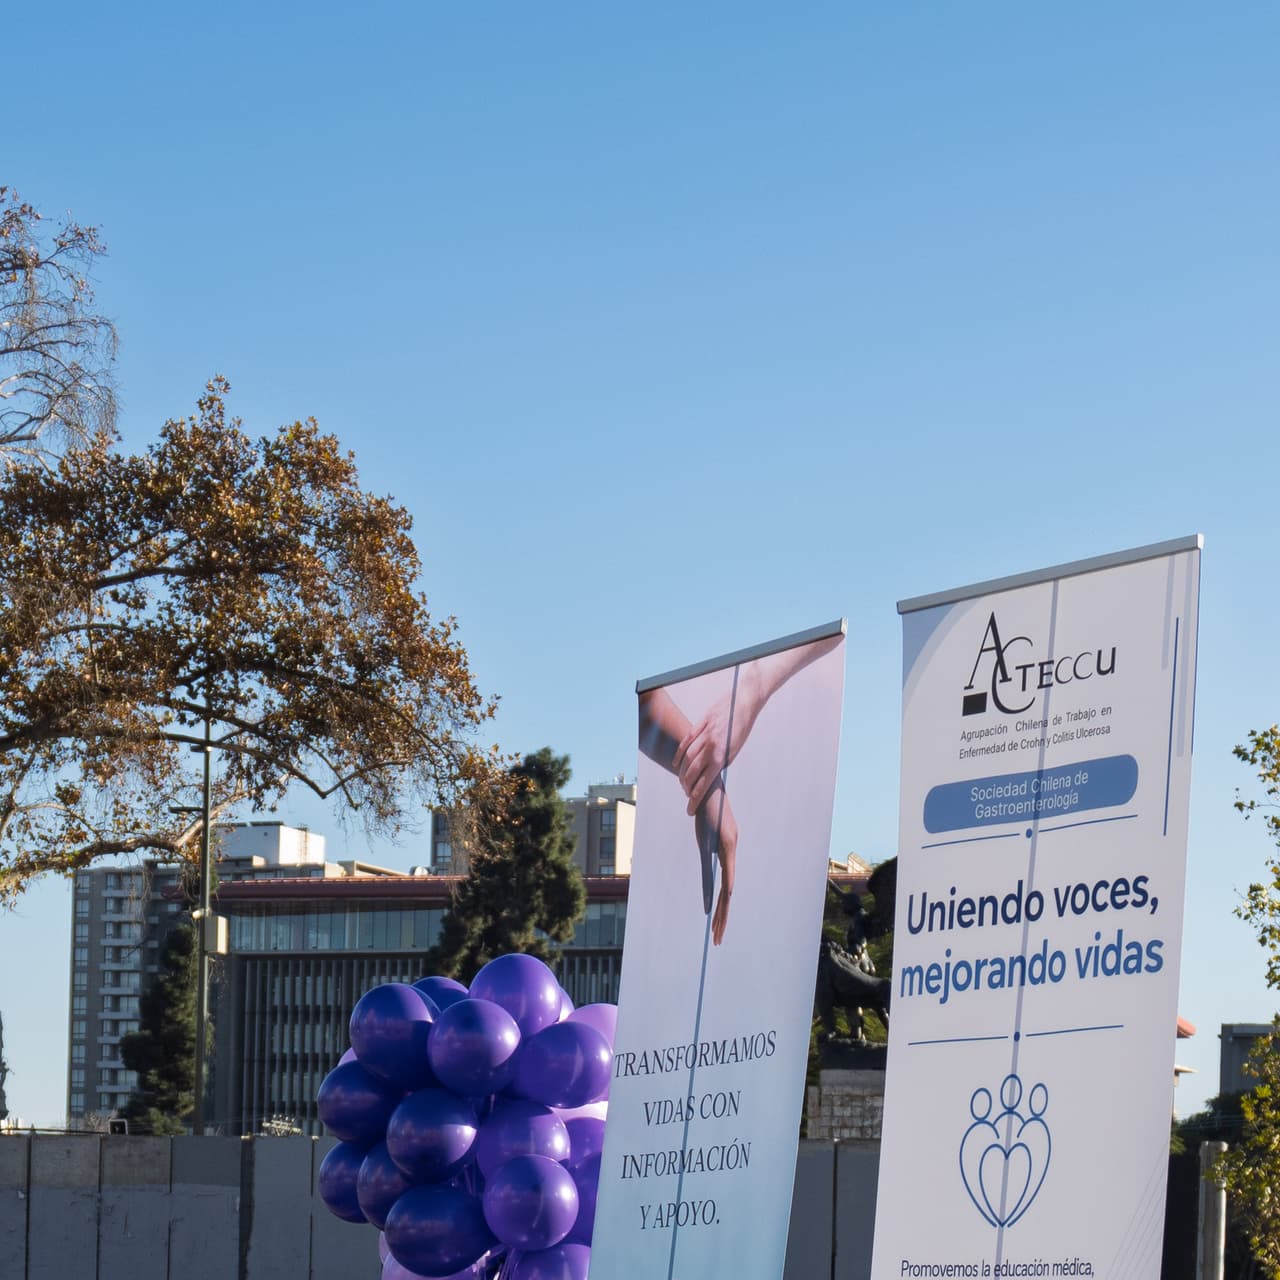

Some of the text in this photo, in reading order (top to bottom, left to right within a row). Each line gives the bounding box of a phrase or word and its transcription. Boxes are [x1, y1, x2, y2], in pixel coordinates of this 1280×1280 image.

[959, 724, 1111, 760] Enfermedad de Crohn y Colitis Ulcerosa
[960, 705, 1112, 743] Agrupación Chilena de Trabajo en
[970, 770, 1089, 802] Sociedad Chilena de
[975, 788, 1079, 819] Gastroenterología
[907, 875, 1160, 935] Uniendo voces,
[900, 928, 1165, 1005] mejorando vidas
[614, 1030, 778, 1078] TRANSFORMAMOS
[643, 1090, 742, 1127] VIDAS CON
[620, 1137, 752, 1180] INFORMACIÓN
[639, 1199, 721, 1230] Y APOYO.
[901, 1257, 1095, 1278] Promovemos la educación médica,
